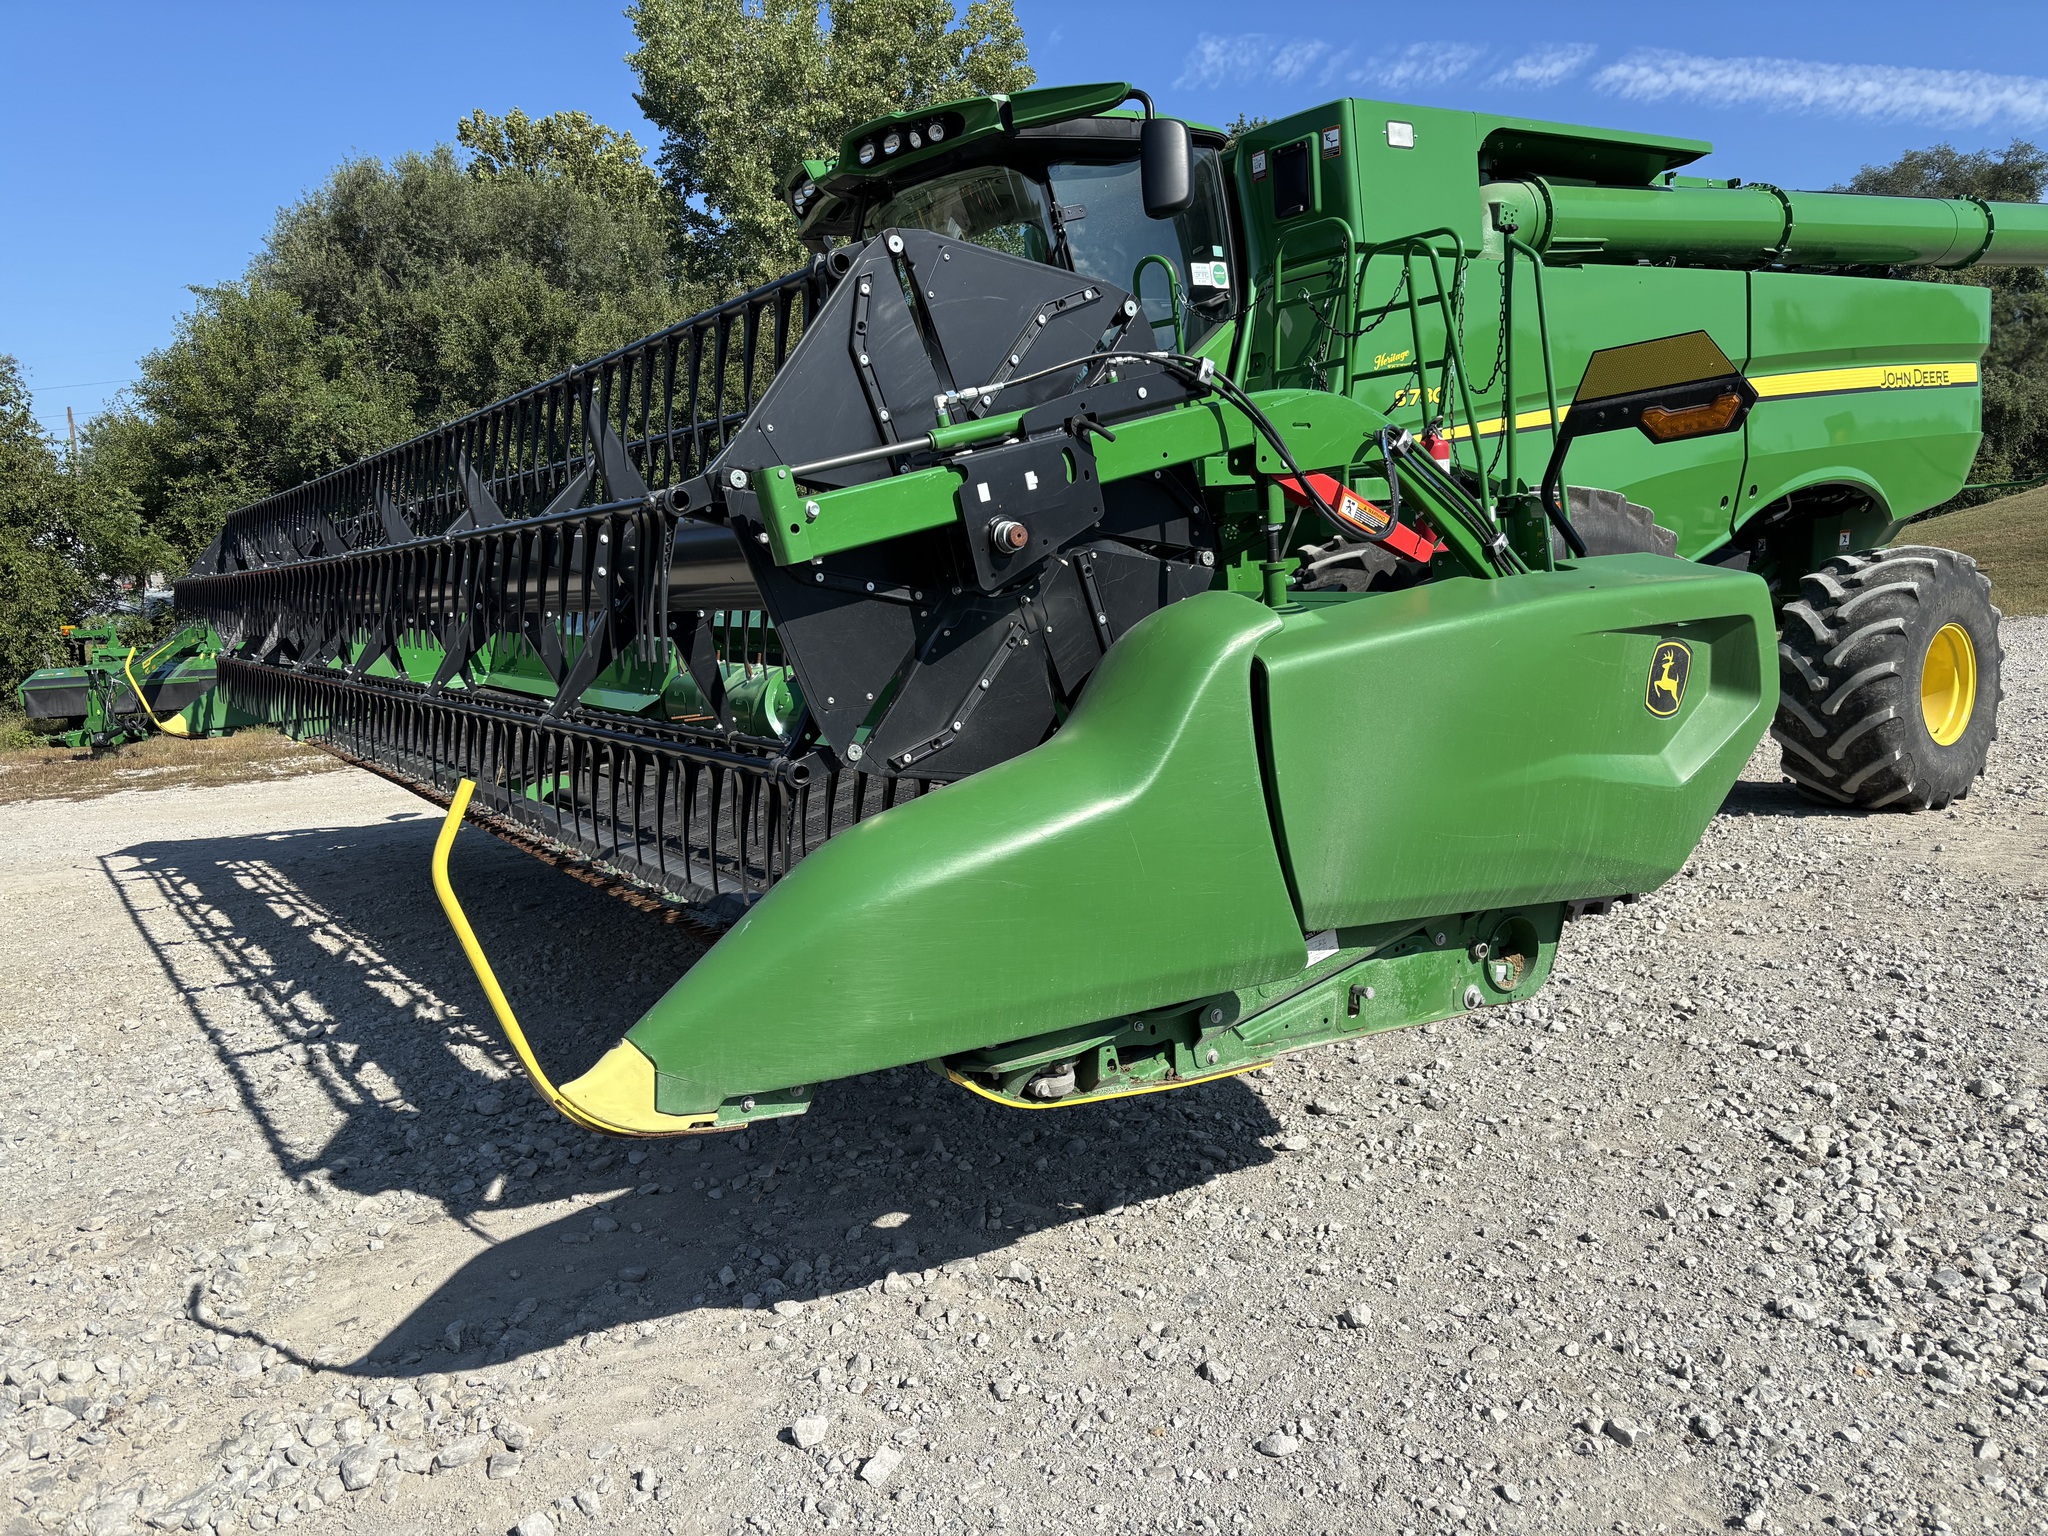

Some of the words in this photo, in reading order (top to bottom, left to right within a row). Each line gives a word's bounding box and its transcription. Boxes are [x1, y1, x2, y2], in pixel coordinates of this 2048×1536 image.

[1373, 349, 1410, 371] Heritage
[1880, 369, 1912, 386] JOHN
[1913, 368, 1950, 385] DEERE
